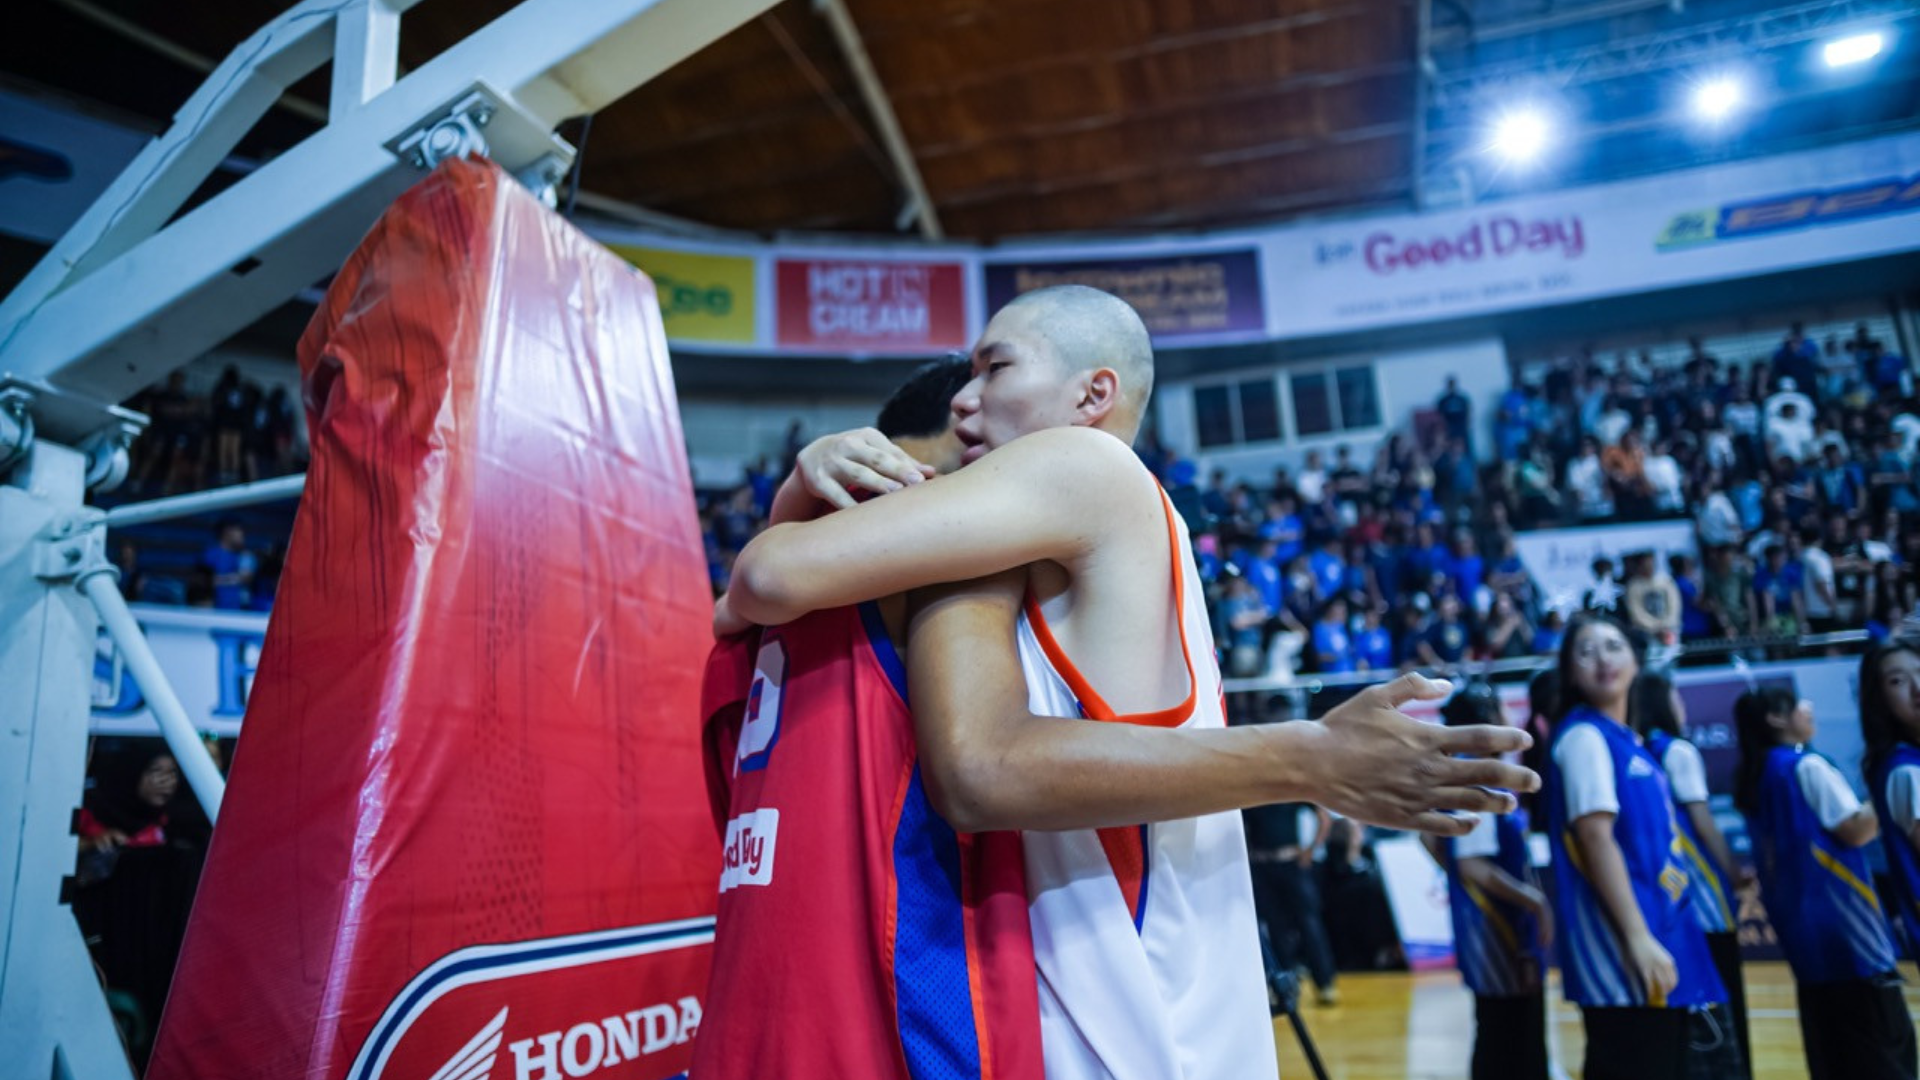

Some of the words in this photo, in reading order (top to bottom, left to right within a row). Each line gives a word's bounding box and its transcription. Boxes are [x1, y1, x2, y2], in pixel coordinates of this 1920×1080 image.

[1364, 213, 1482, 276] Good
[1489, 211, 1586, 259] Day
[809, 263, 884, 299] HOT
[809, 301, 929, 337] CREAM
[509, 996, 703, 1080] HONDA
